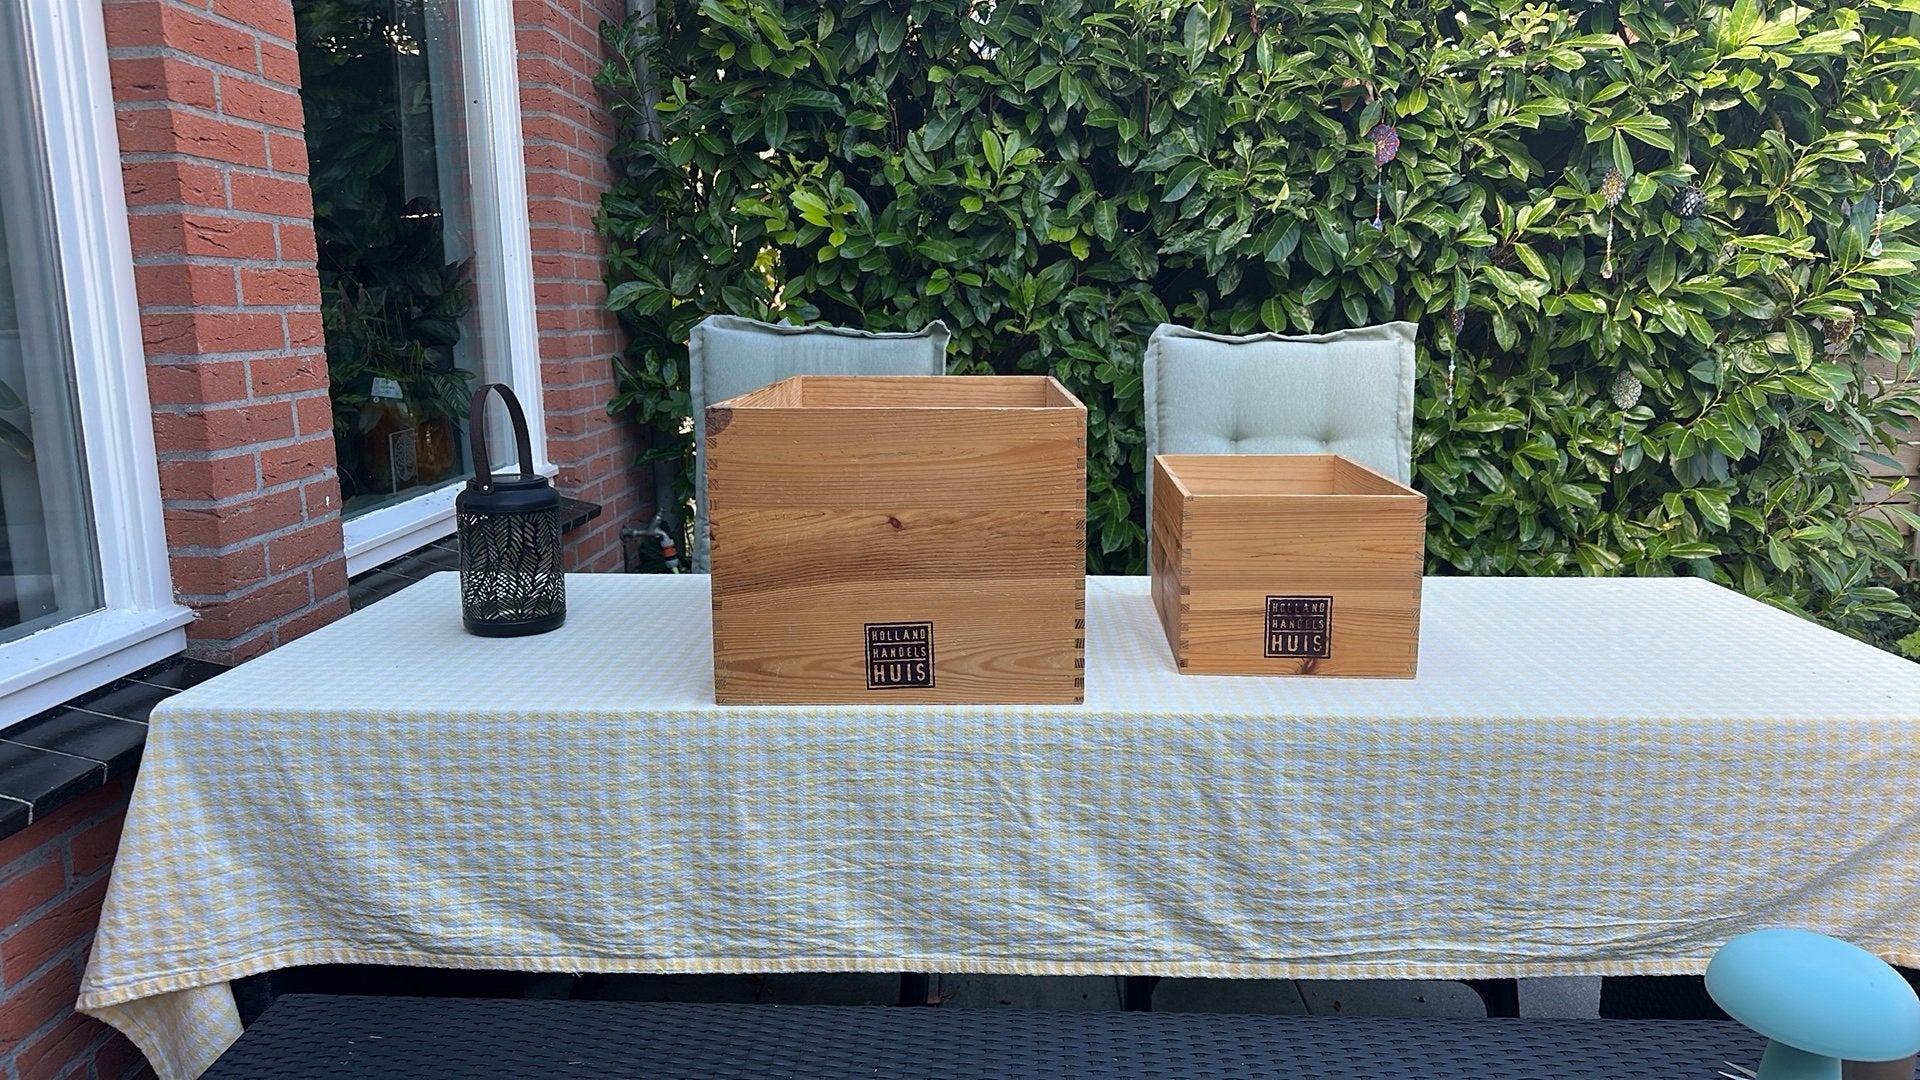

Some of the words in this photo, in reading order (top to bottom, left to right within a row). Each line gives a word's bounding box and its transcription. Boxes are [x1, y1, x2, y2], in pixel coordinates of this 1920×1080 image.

[872, 628, 926, 641] HOLLAND
[1271, 634, 1322, 652] HUIS
[873, 646, 926, 658] HANDELS
[873, 663, 926, 683] HUIS
